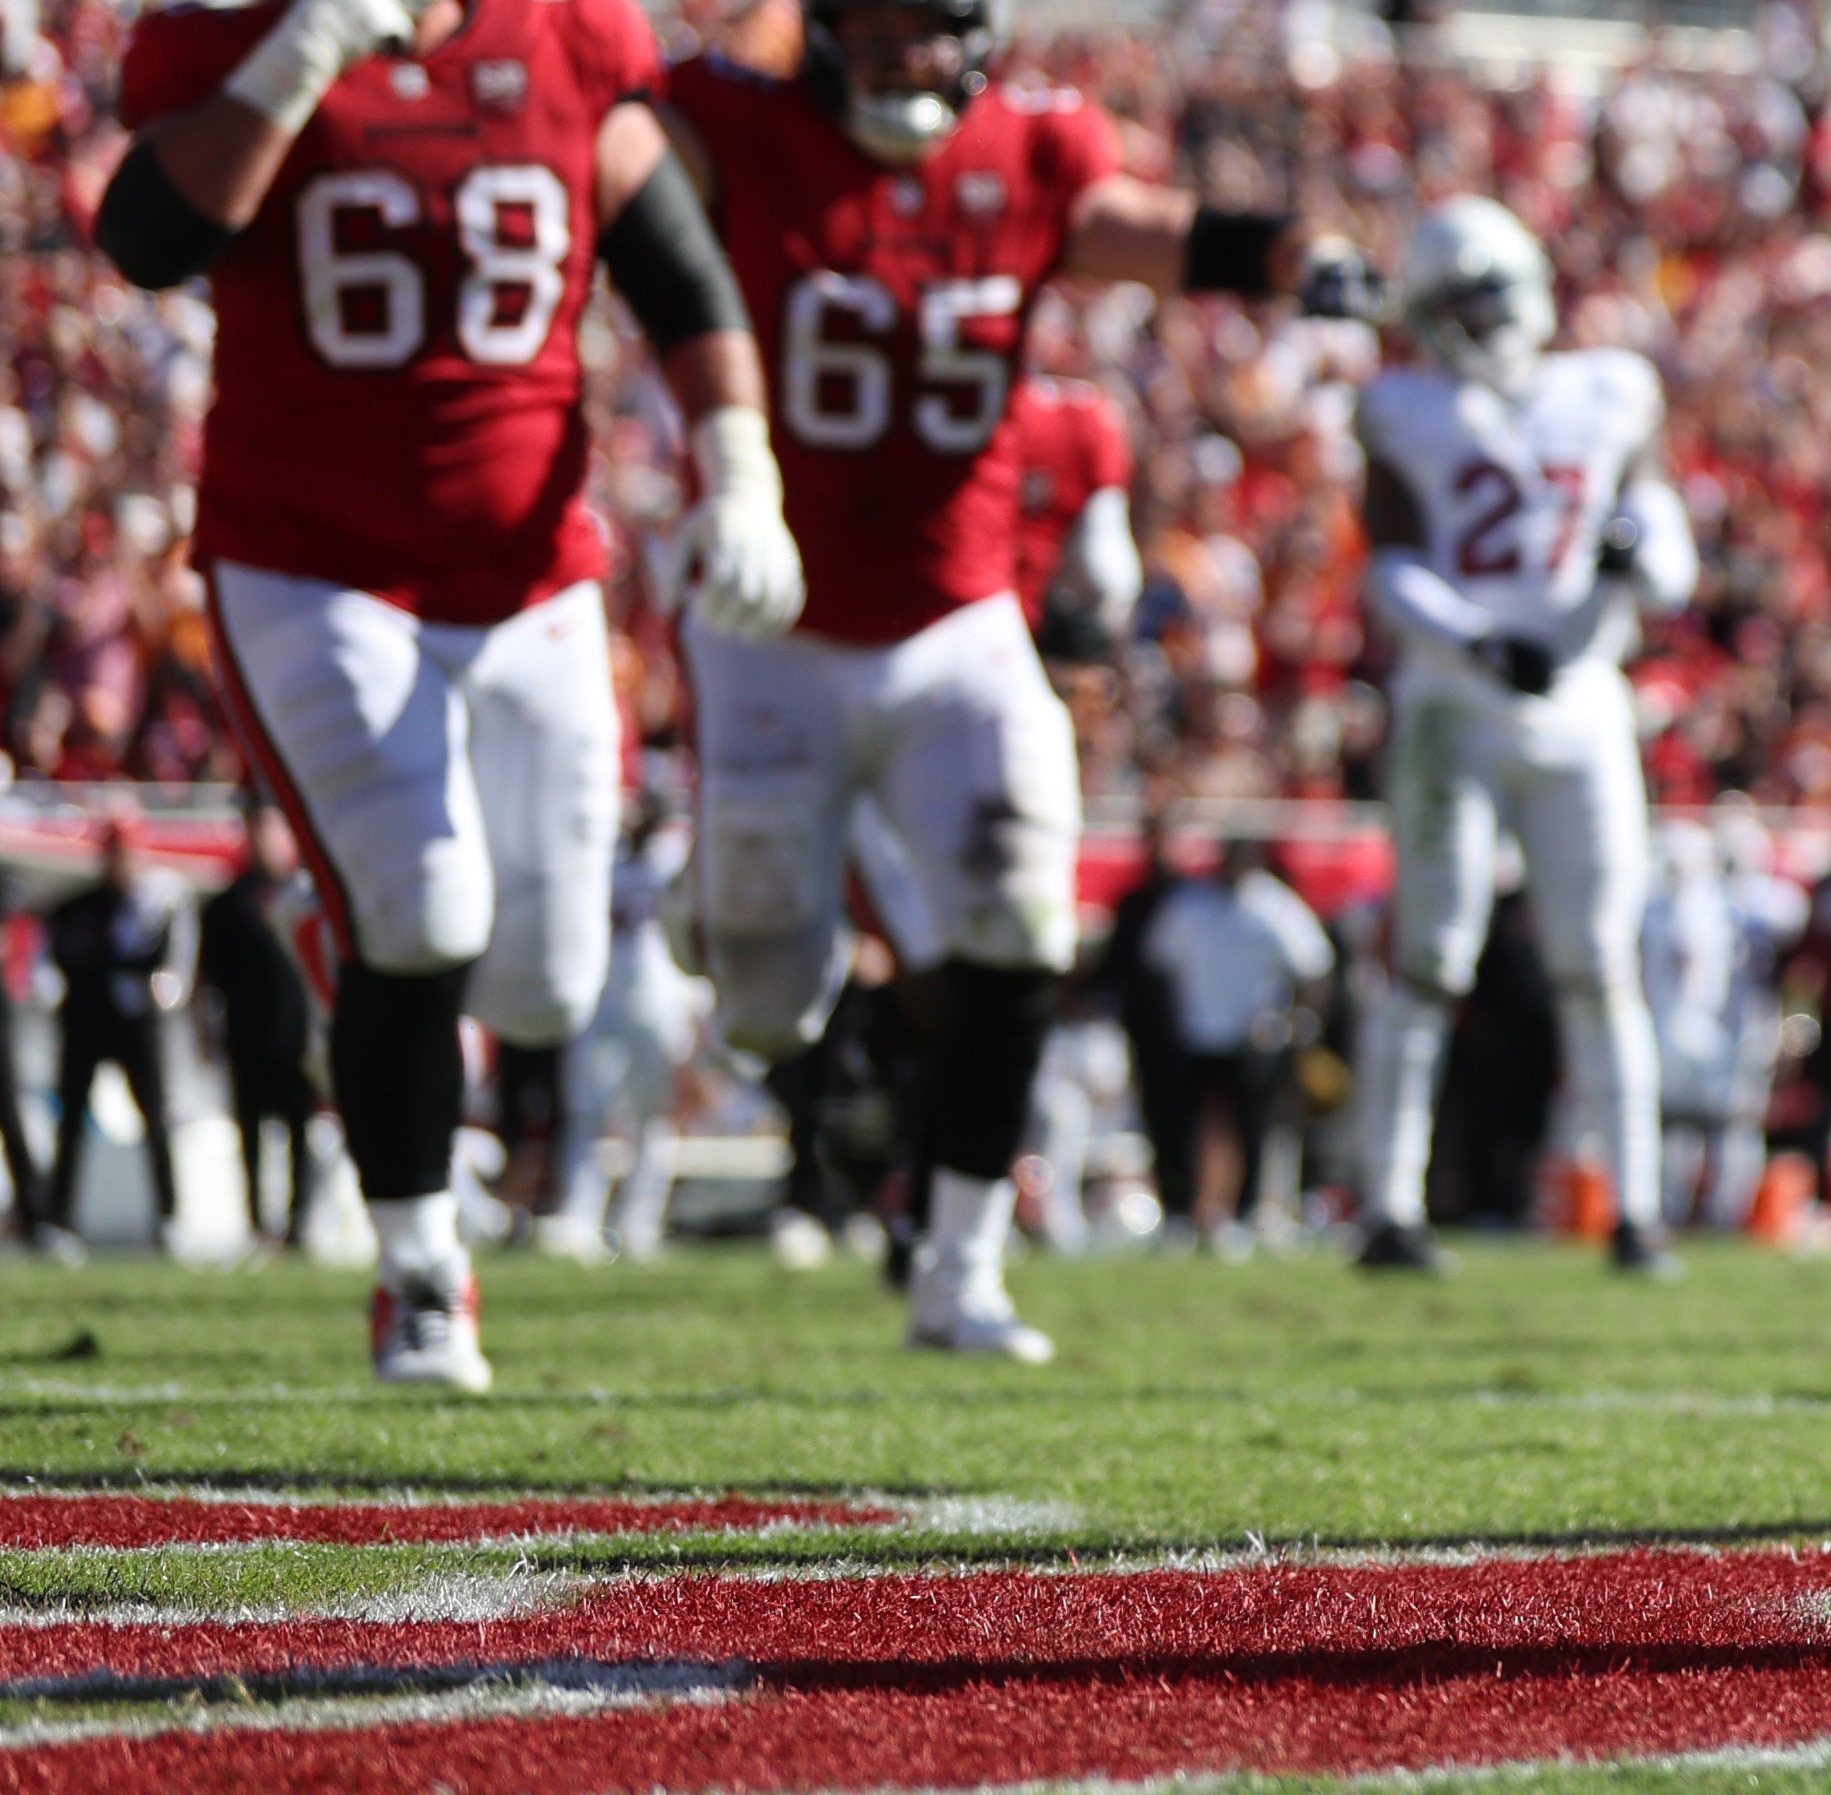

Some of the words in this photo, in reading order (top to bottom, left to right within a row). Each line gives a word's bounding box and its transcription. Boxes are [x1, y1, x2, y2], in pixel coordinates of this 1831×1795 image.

[295, 163, 570, 368] 68
[784, 271, 1021, 451] 65
[1452, 461, 1588, 578] 27
